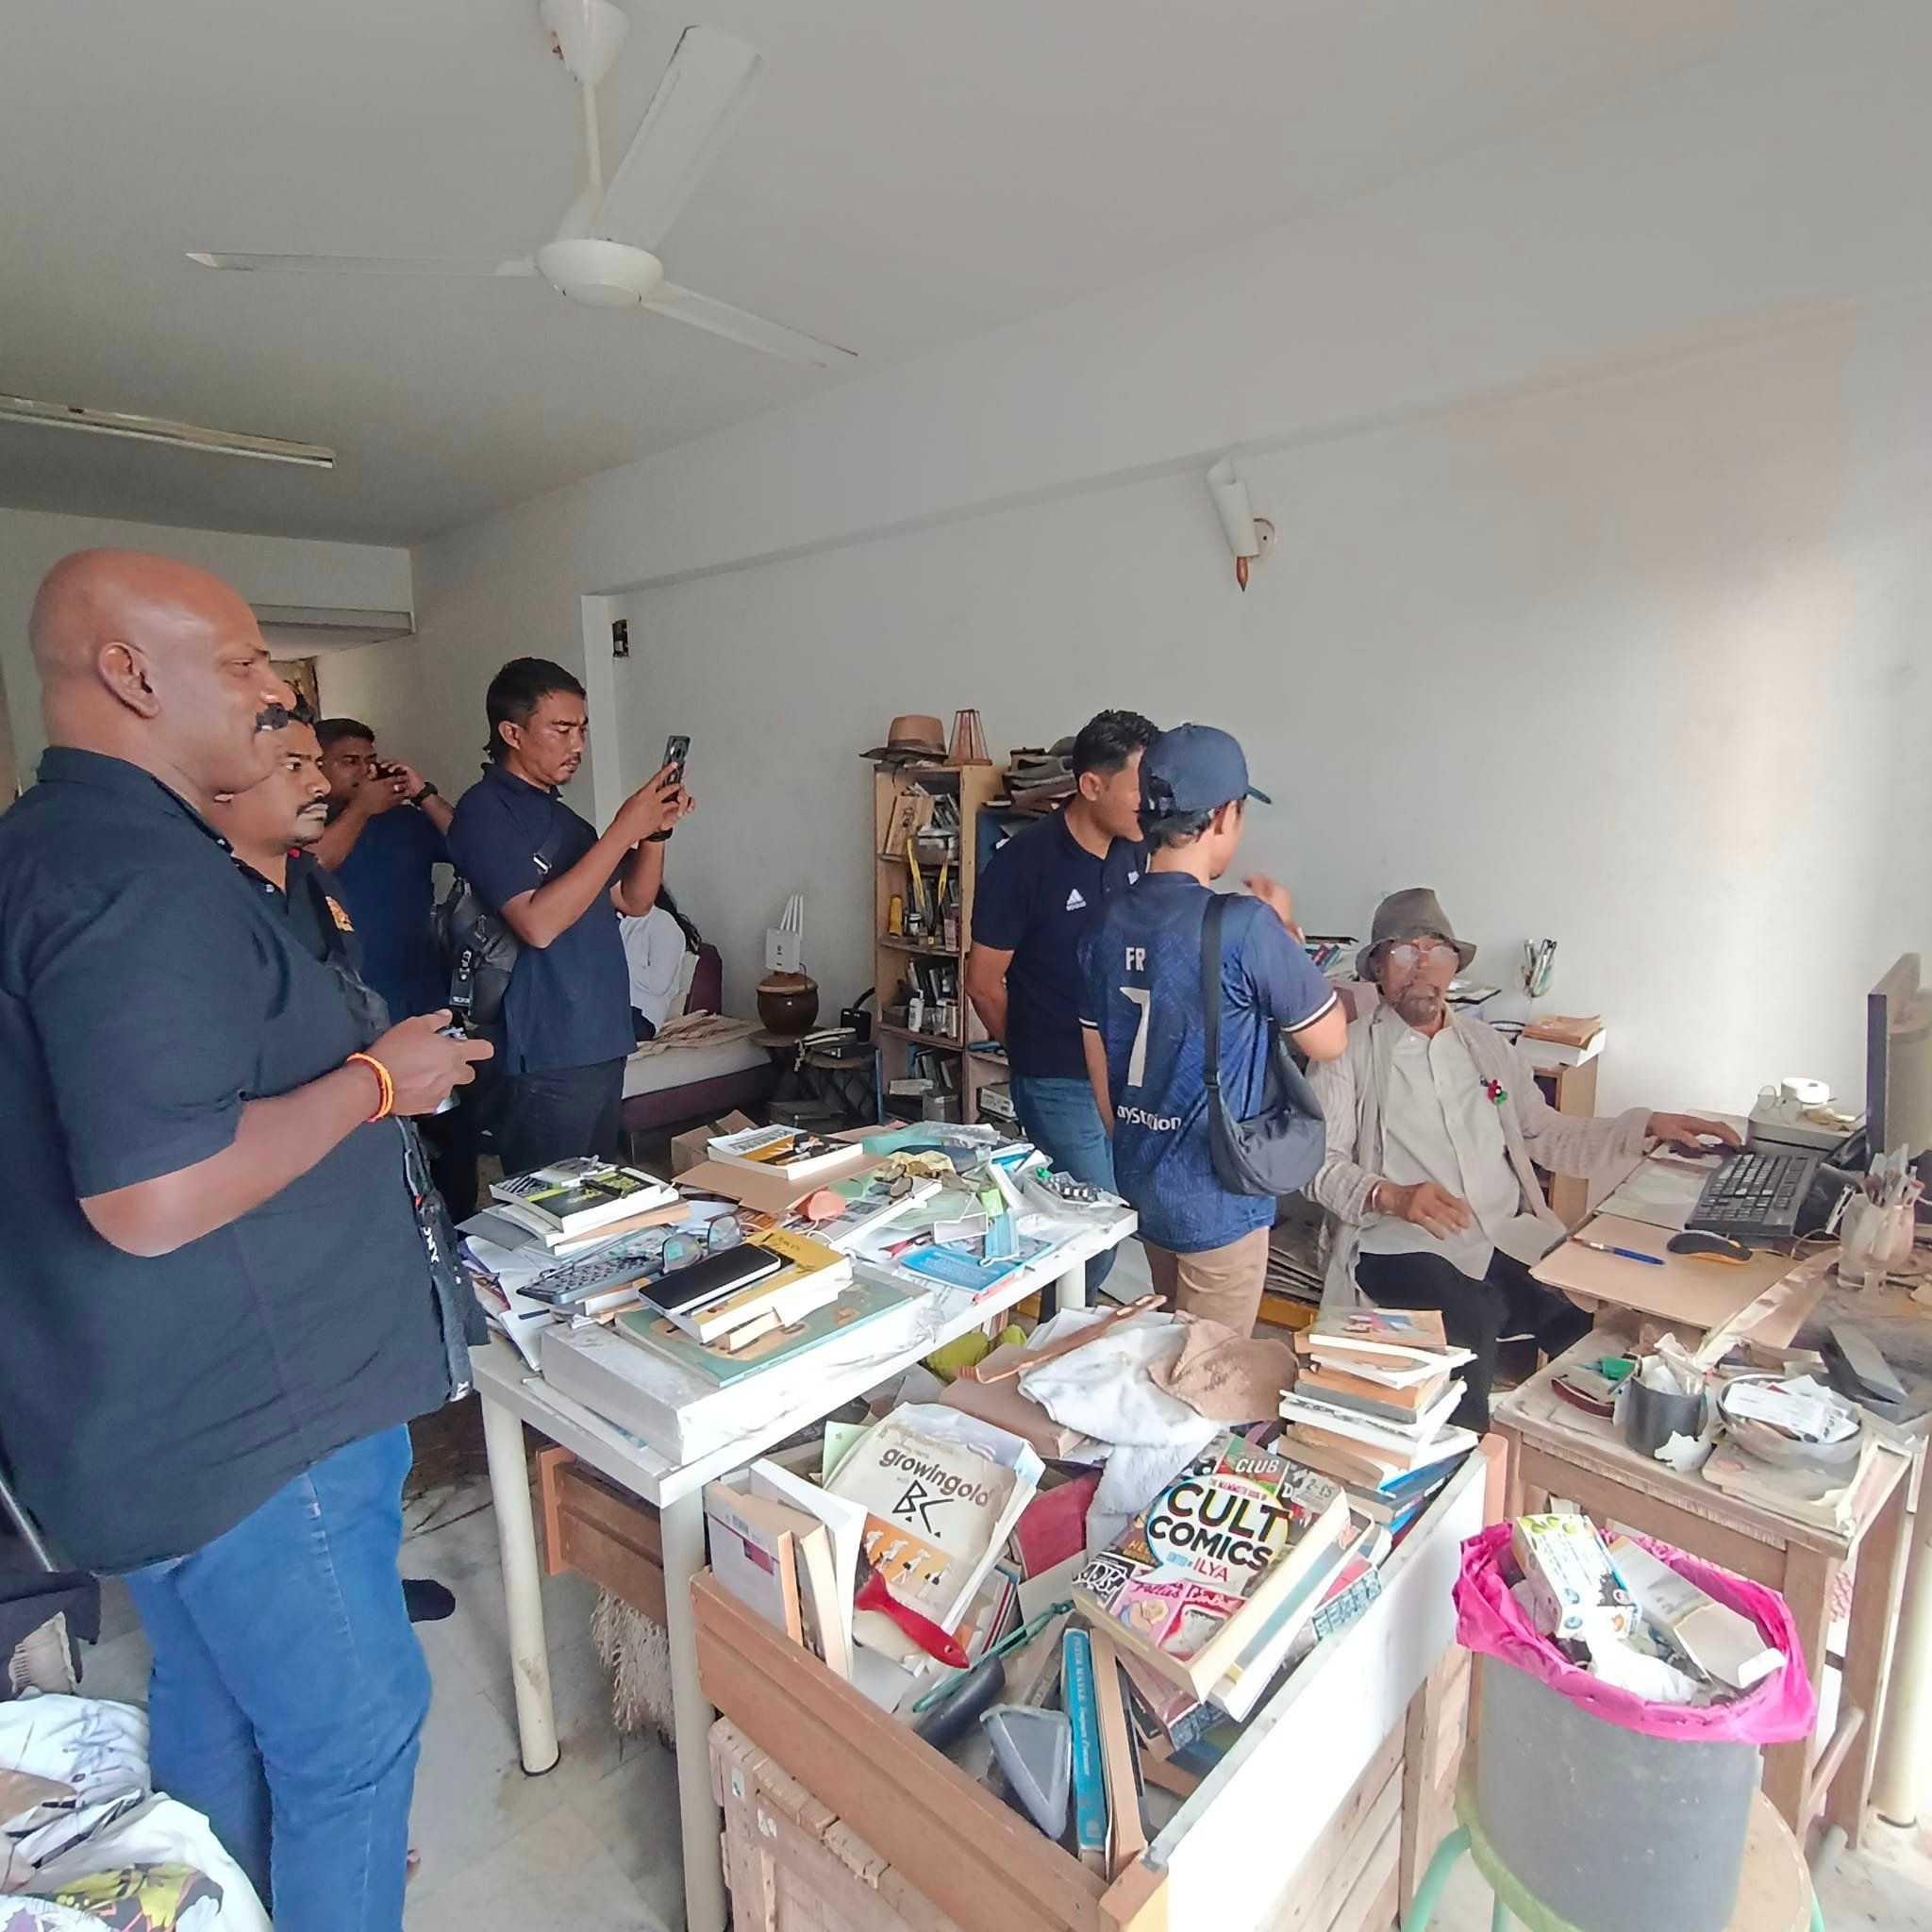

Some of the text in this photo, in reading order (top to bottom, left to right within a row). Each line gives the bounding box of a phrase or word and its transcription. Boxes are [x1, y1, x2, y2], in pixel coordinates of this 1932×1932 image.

[1124, 946, 1146, 972] FR
[1119, 986, 1150, 1087] 7
[1235, 1457, 1279, 1474] CLUB
[1167, 1482, 1291, 1542] CULT
[1148, 1515, 1274, 1572] COMICS
[1192, 1557, 1229, 1583] ILYA
